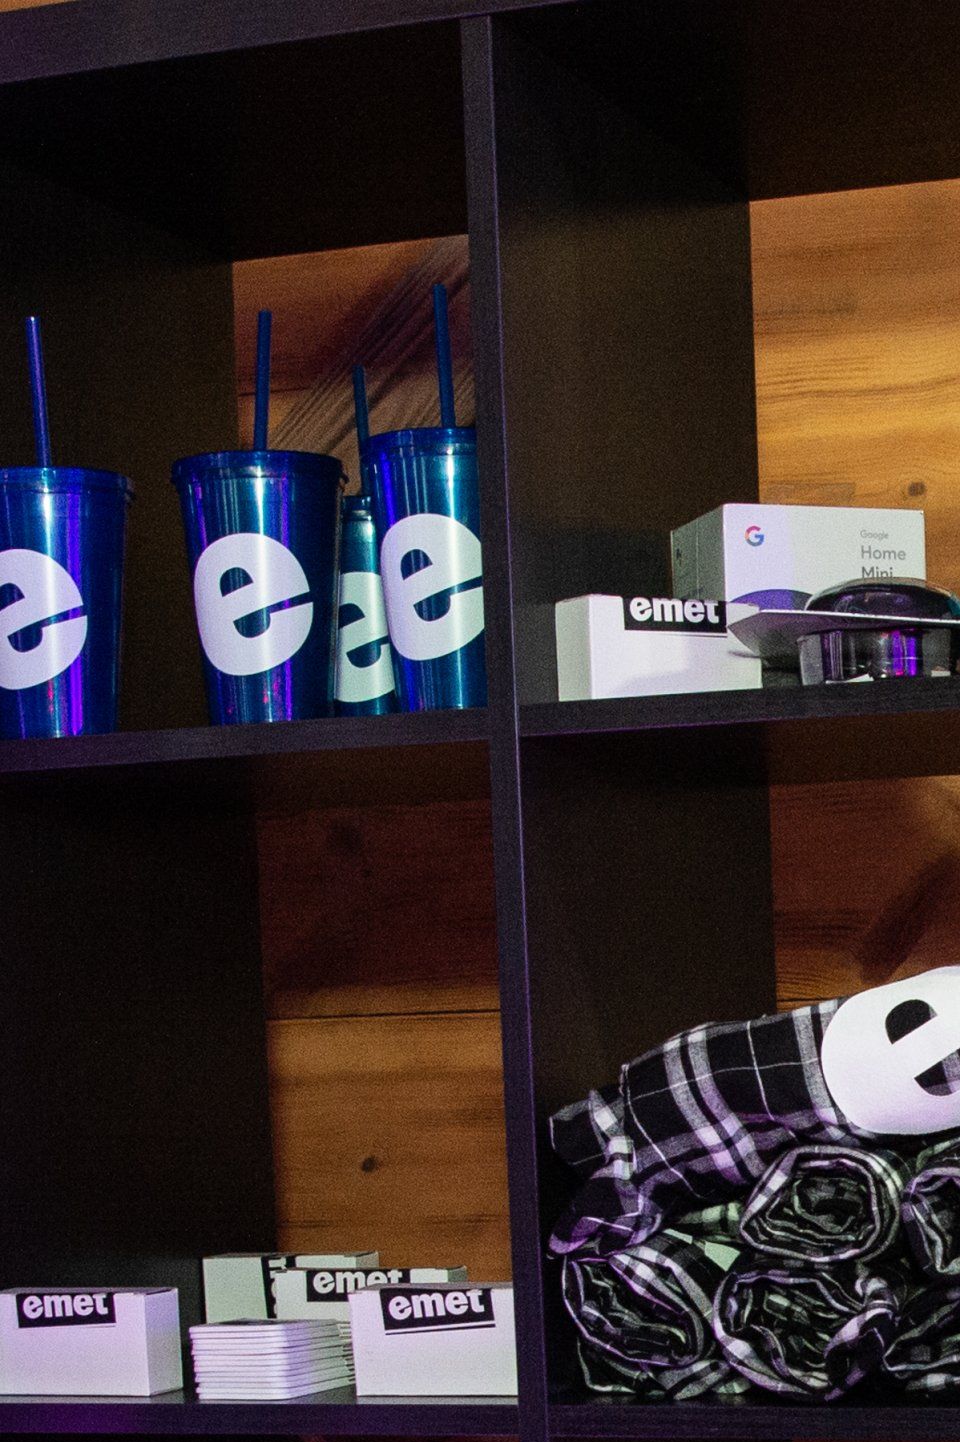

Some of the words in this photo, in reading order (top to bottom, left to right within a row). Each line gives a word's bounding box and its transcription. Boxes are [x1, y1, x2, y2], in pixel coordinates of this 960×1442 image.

[861, 545, 906, 560] Home
[380, 512, 486, 662] e
[0, 547, 88, 690] e
[193, 531, 316, 677] e
[629, 597, 720, 624] emet
[22, 1293, 109, 1319] emet
[388, 1289, 485, 1320] emet
